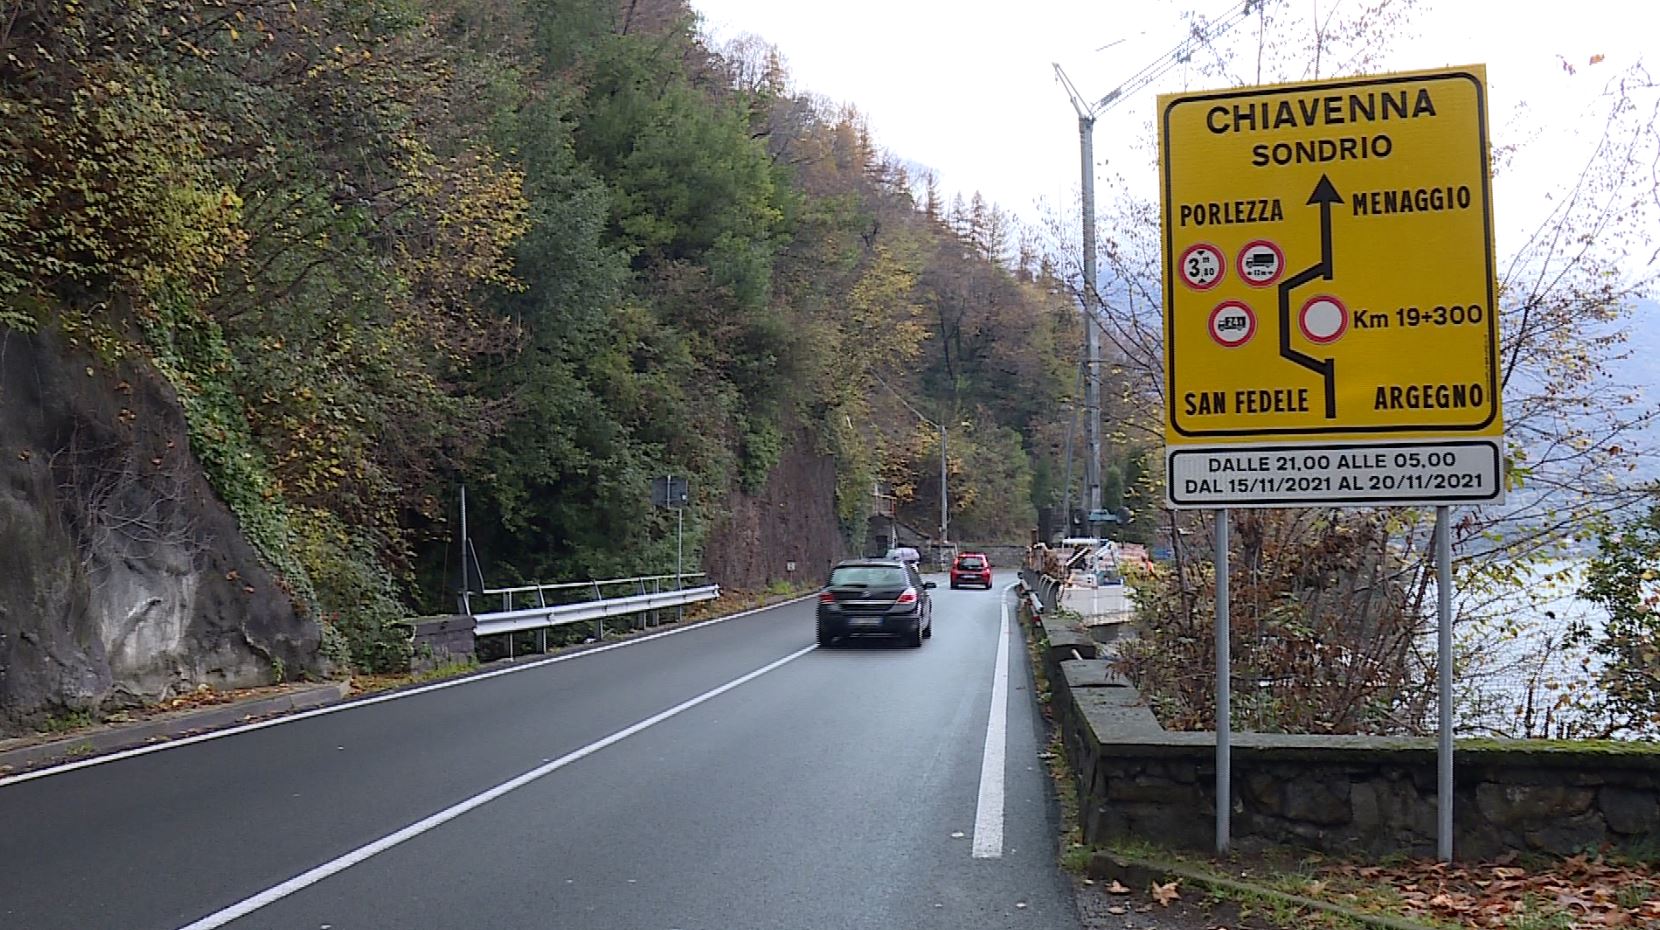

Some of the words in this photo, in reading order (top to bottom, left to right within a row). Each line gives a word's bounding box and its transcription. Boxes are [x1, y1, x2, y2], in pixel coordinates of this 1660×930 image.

[1206, 88, 1437, 134] CHIAVENNA
[1252, 135, 1392, 166] SONDRIO
[1181, 200, 1283, 226] PORLEZZA
[1353, 186, 1470, 216] MENAGGIO
[1354, 310, 1388, 328] Km
[1185, 392, 1225, 415] SAN
[1236, 389, 1308, 413] FEDELE
[1375, 384, 1482, 410] ARGEGNO
[1209, 457, 1270, 472] DALLE
[1337, 455, 1386, 469] ALLE
[1186, 480, 1223, 493] DAL
[1229, 477, 1330, 492] 15/11/2021
[1338, 476, 1364, 490] AL
[1369, 474, 1481, 490] 20/11/2021
